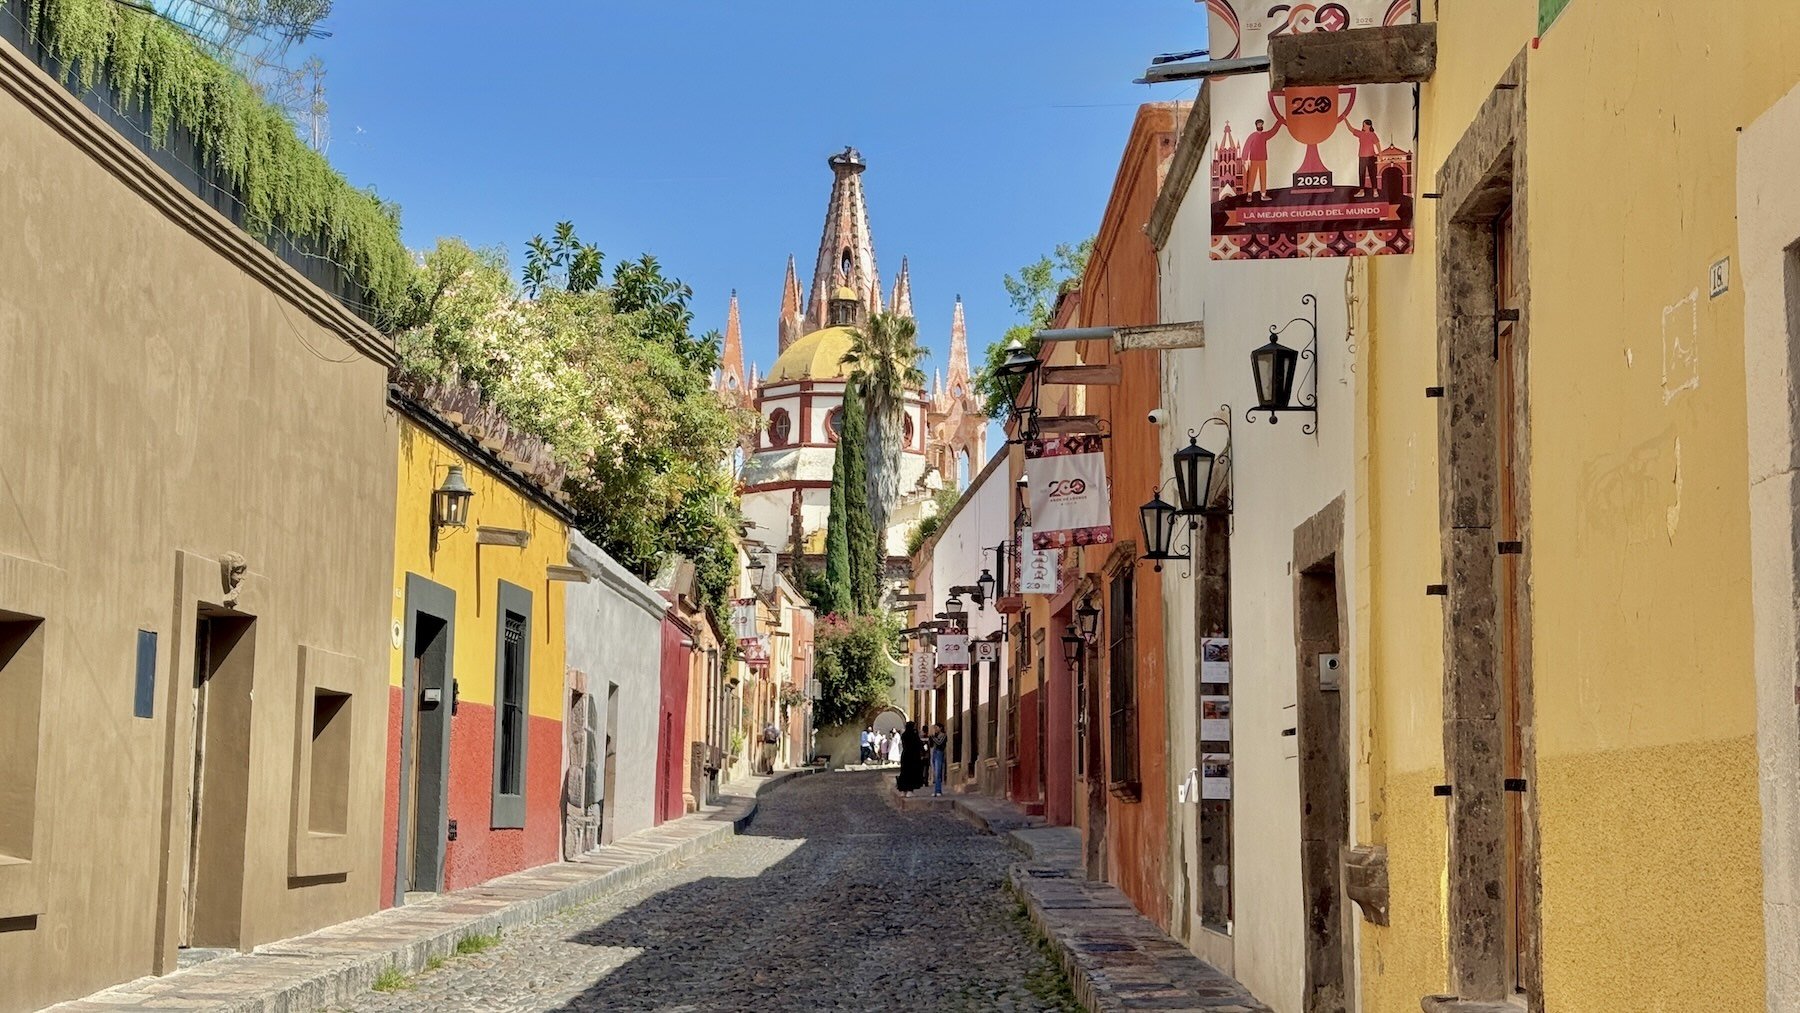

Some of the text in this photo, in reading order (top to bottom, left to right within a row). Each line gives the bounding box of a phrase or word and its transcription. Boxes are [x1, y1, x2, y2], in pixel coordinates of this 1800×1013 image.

[1291, 96, 1332, 115] 200
[1297, 175, 1328, 186] 2026
[1243, 207, 1380, 219] LA MEJOR CIUDAD DEL MUNDO
[1048, 478, 1086, 497] 200
